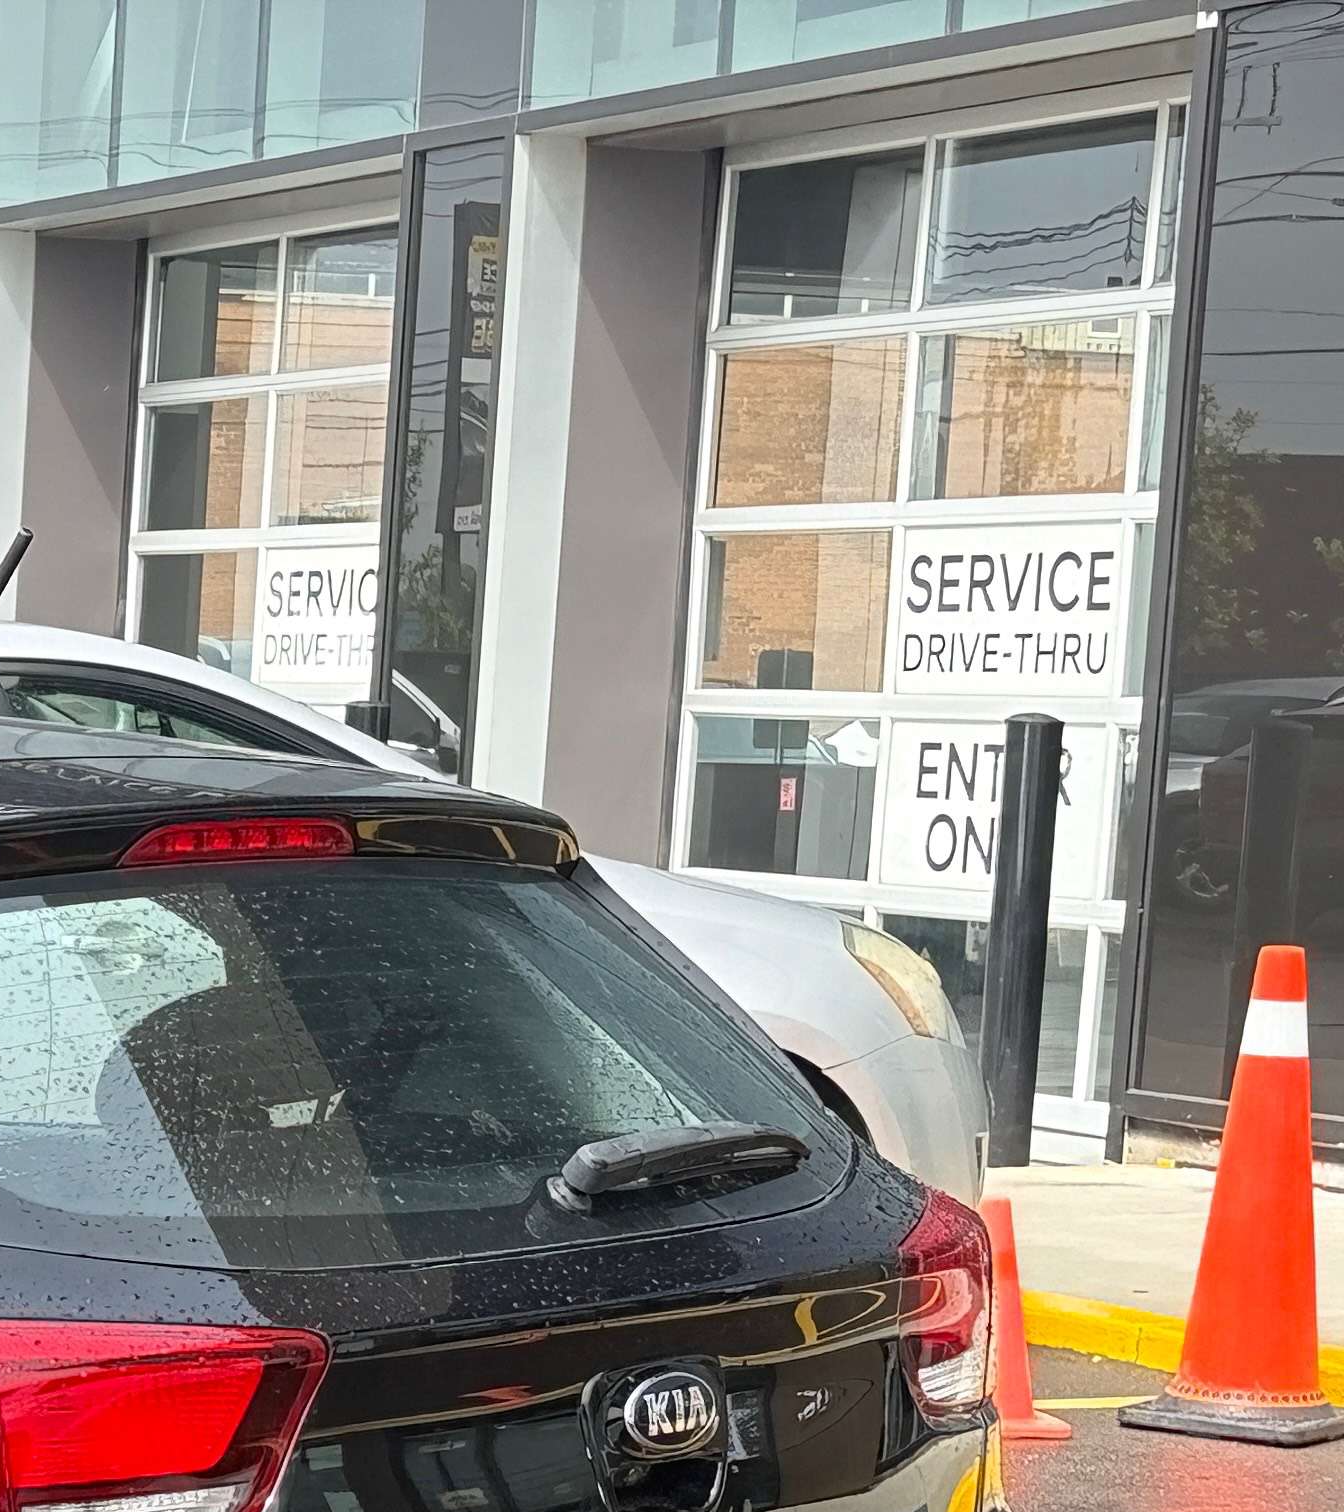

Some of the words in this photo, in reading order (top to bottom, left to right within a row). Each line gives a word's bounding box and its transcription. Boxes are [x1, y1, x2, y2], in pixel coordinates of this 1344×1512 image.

[266, 568, 379, 618] SERVIC
[906, 551, 1115, 614] SERVICE
[263, 633, 375, 666] DRIVE-THR
[902, 632, 1108, 675] DRIVE-THRU
[916, 741, 1072, 807] ENTR
[643, 1385, 708, 1437] KIA
